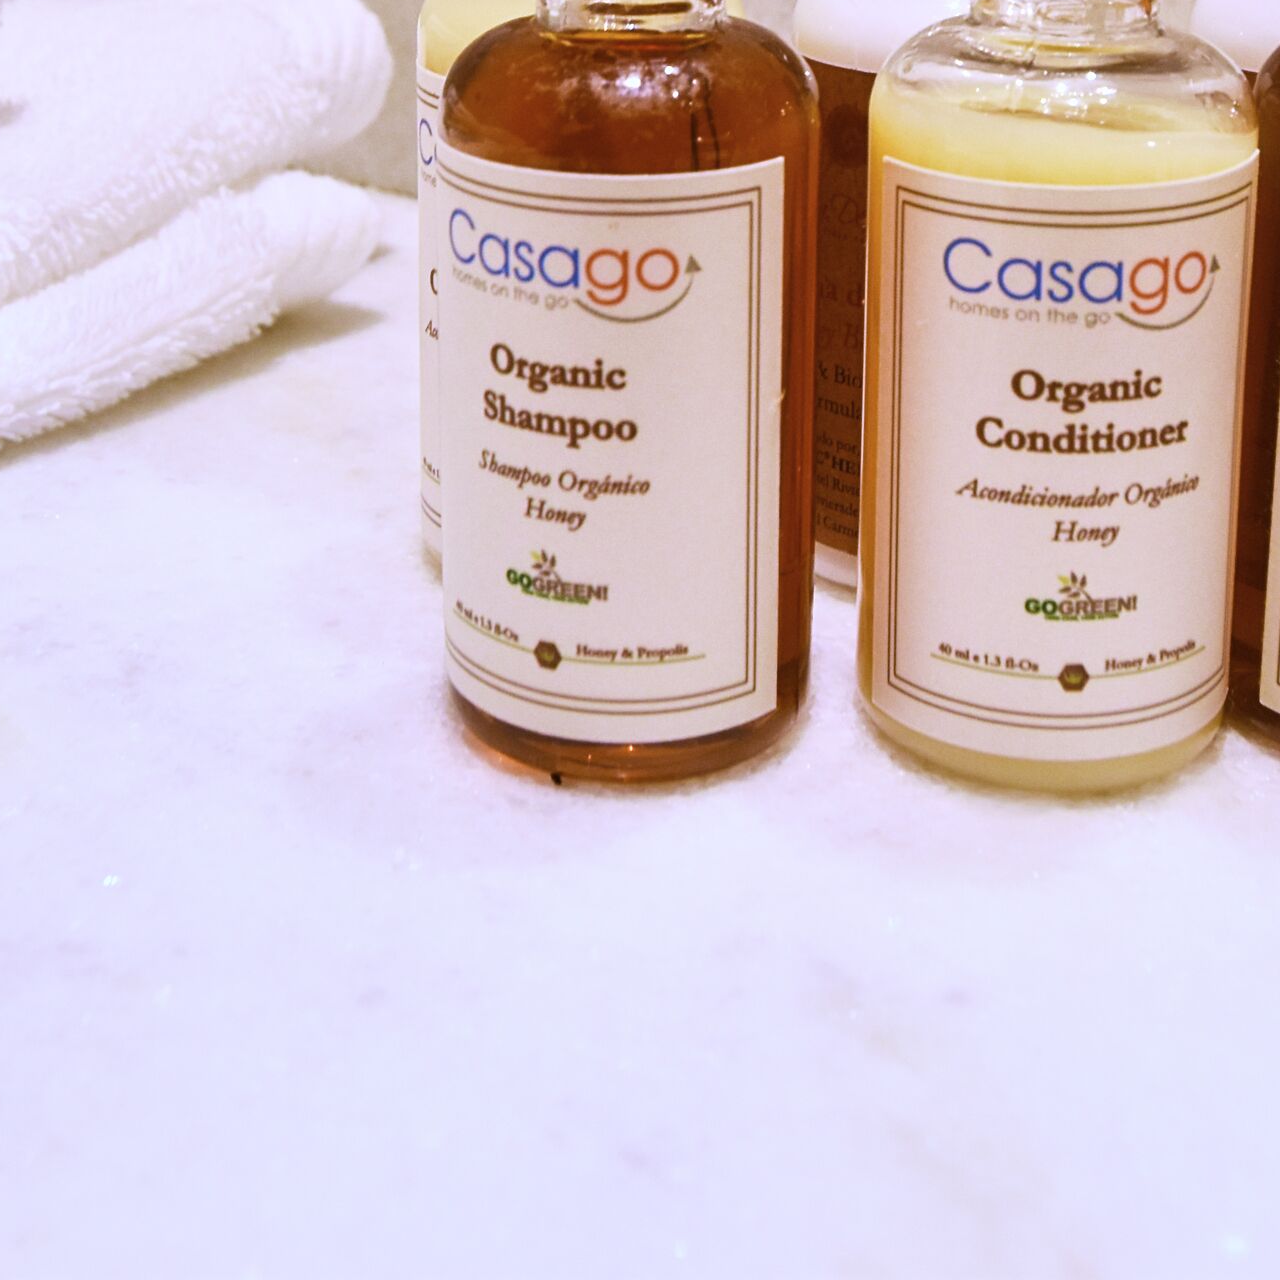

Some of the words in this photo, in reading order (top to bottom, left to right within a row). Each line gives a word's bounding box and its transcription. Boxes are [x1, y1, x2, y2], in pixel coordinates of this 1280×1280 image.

[449, 208, 679, 306] Casago
[943, 237, 1207, 316] Casago
[490, 283, 509, 297] on
[513, 285, 539, 306] the
[545, 294, 570, 311] go
[949, 296, 1009, 320] homes
[1015, 308, 1041, 322] on
[1046, 307, 1078, 324] the
[1084, 310, 1111, 329] go
[490, 343, 627, 393] Organic
[1011, 368, 1162, 414] Organic
[484, 390, 638, 449] Shampoo
[975, 416, 1189, 455] Conditioner
[478, 449, 551, 488] Shampoo
[558, 469, 651, 500] Orgánico
[955, 478, 1120, 509] Acondicionador
[1124, 473, 1200, 508] Orgánico
[524, 497, 587, 531] Honey
[1051, 520, 1120, 548] Honey
[576, 644, 618, 662] Honey
[621, 648, 633, 659] &
[637, 644, 688, 662] Propolis
[938, 642, 953, 656] 40
[955, 647, 970, 661] ml
[983, 653, 1002, 668] 1.3
[1105, 656, 1143, 673] Honey
[1146, 653, 1157, 665] &
